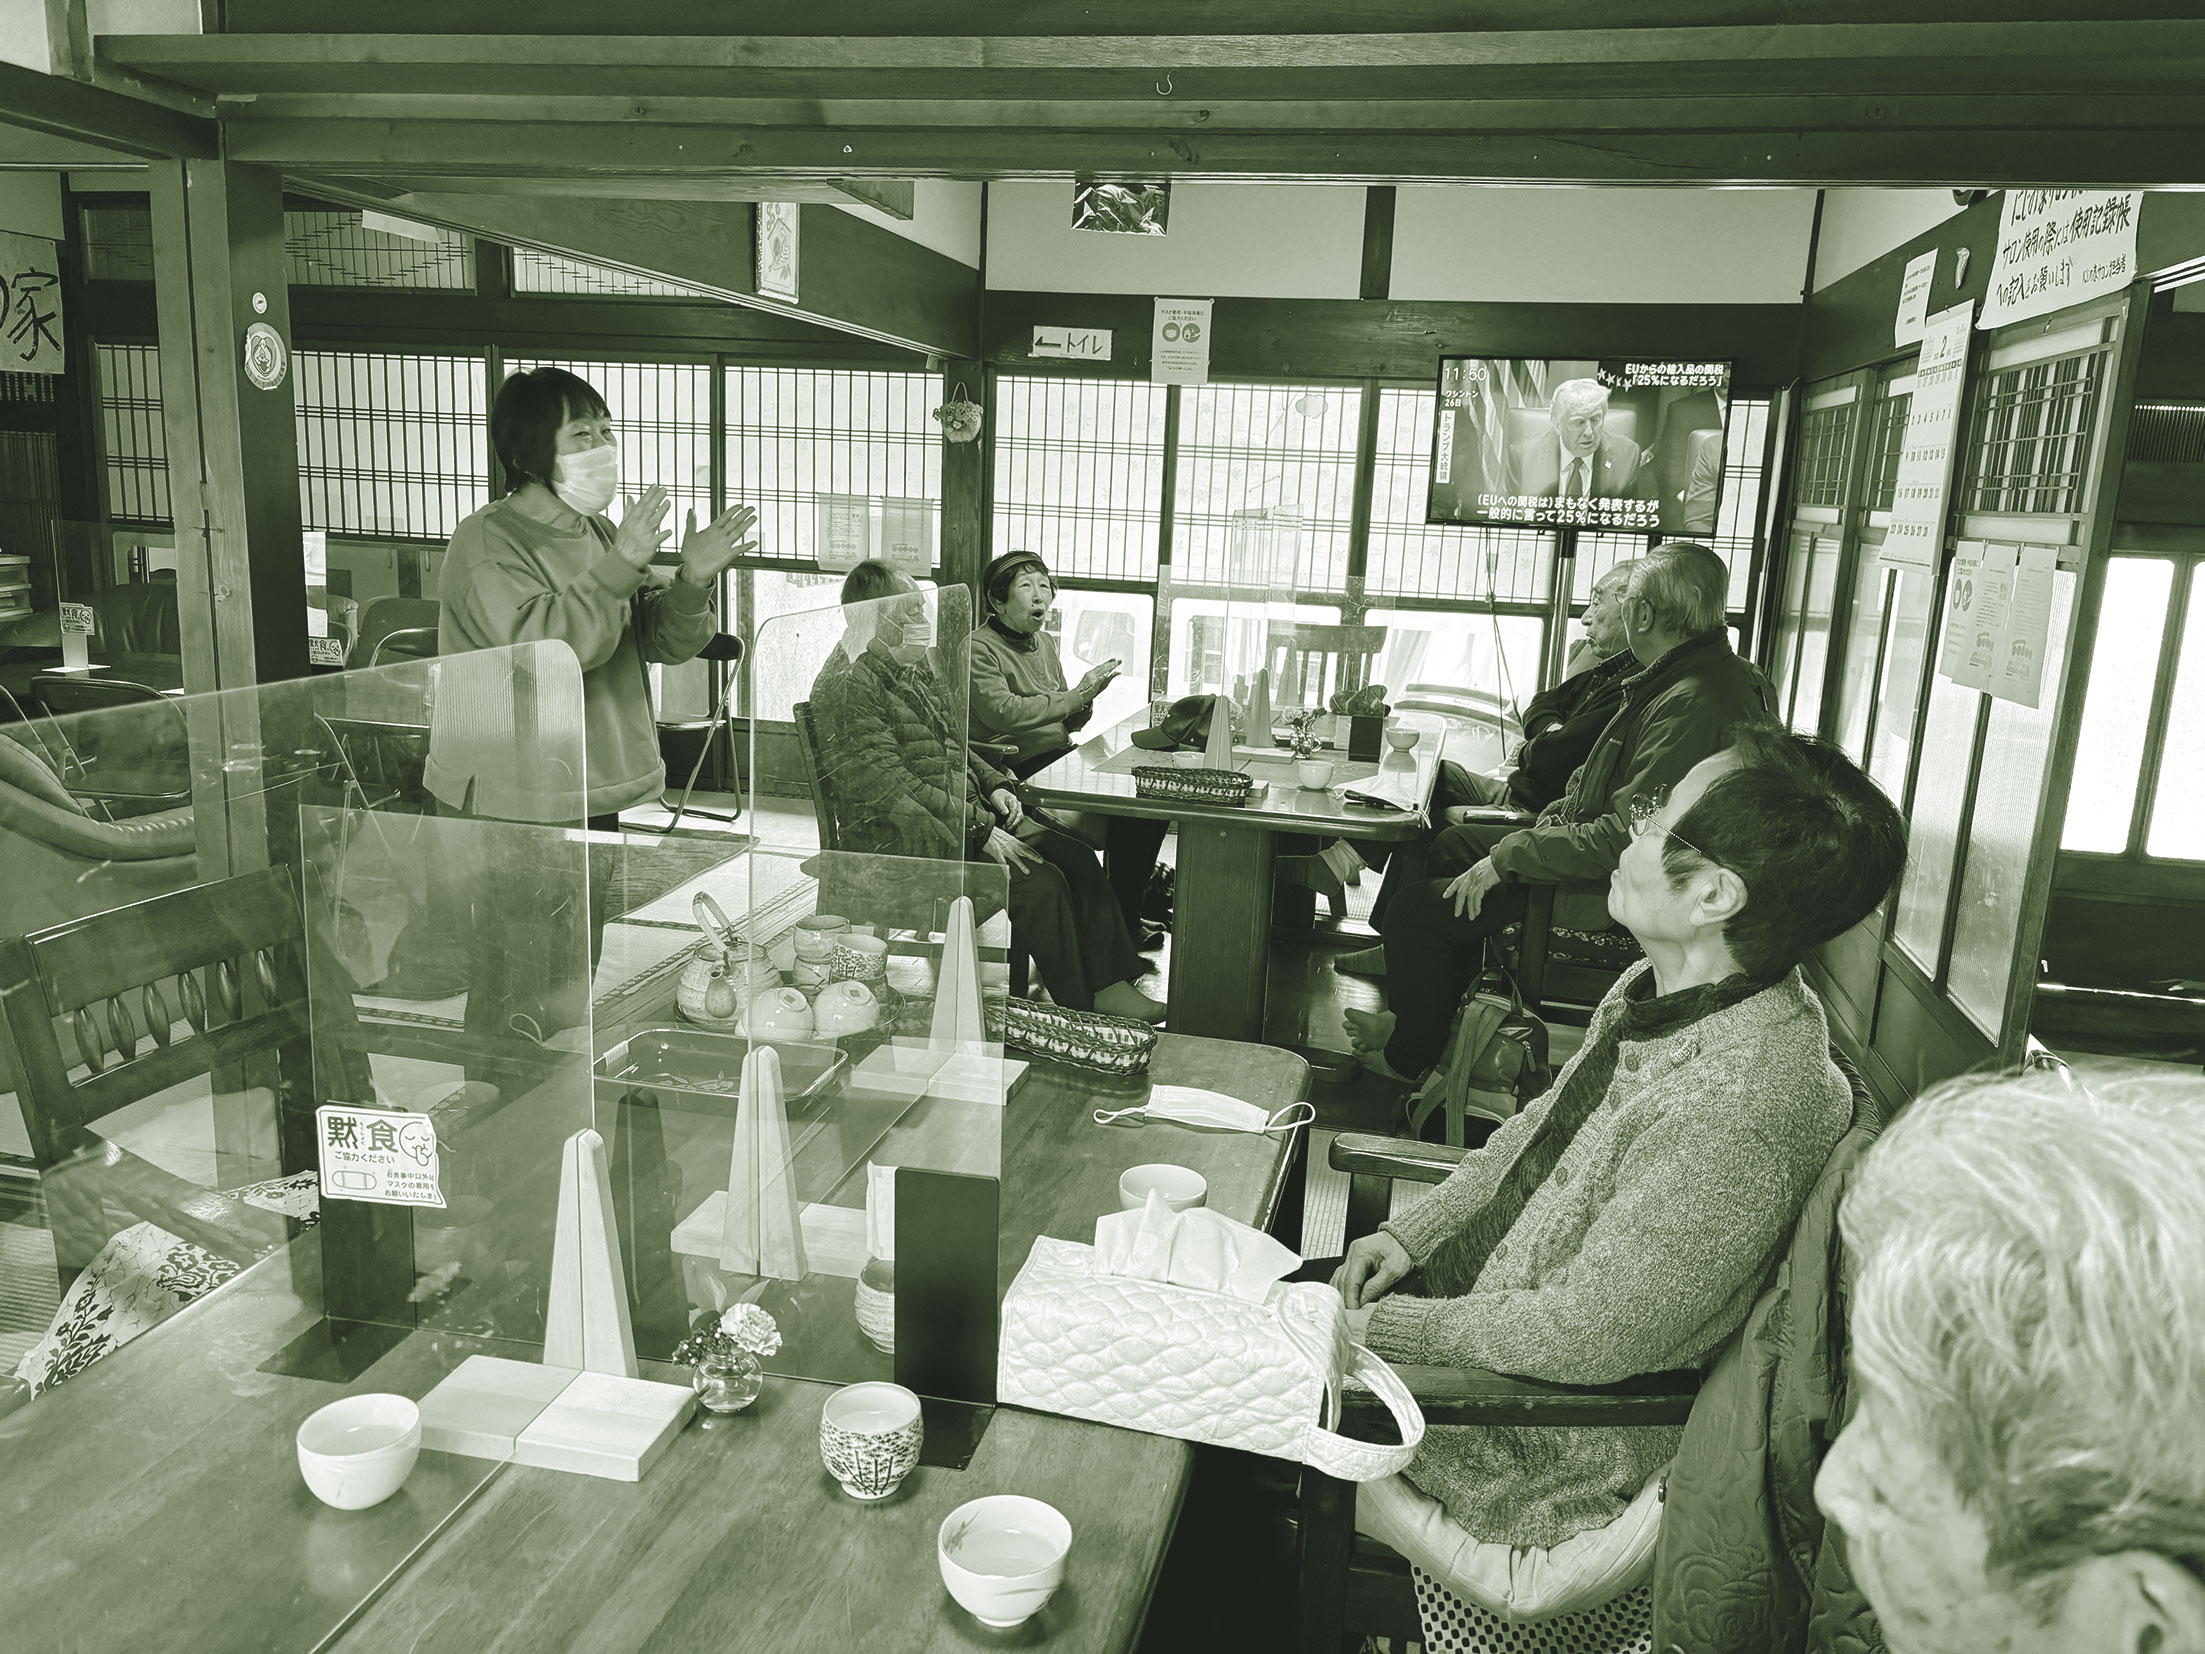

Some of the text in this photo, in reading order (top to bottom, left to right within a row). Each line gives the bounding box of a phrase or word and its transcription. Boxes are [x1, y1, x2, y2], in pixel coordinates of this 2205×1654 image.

[1067, 332, 1103, 355] トイレ
[1444, 367, 1487, 381] 11:50
[1625, 363, 1724, 375] EUからの輸入品の関税
[1445, 390, 1479, 398] ワシントン
[1444, 398, 1461, 407] 26日
[1439, 412, 1451, 480] トランプ大統領
[1476, 507, 1660, 528] 一般的に言って25%になるだろう
[327, 1116, 399, 1153] 黙食
[335, 1151, 395, 1164] ご協力ください
[385, 1190, 433, 1199] お願いいたしま
